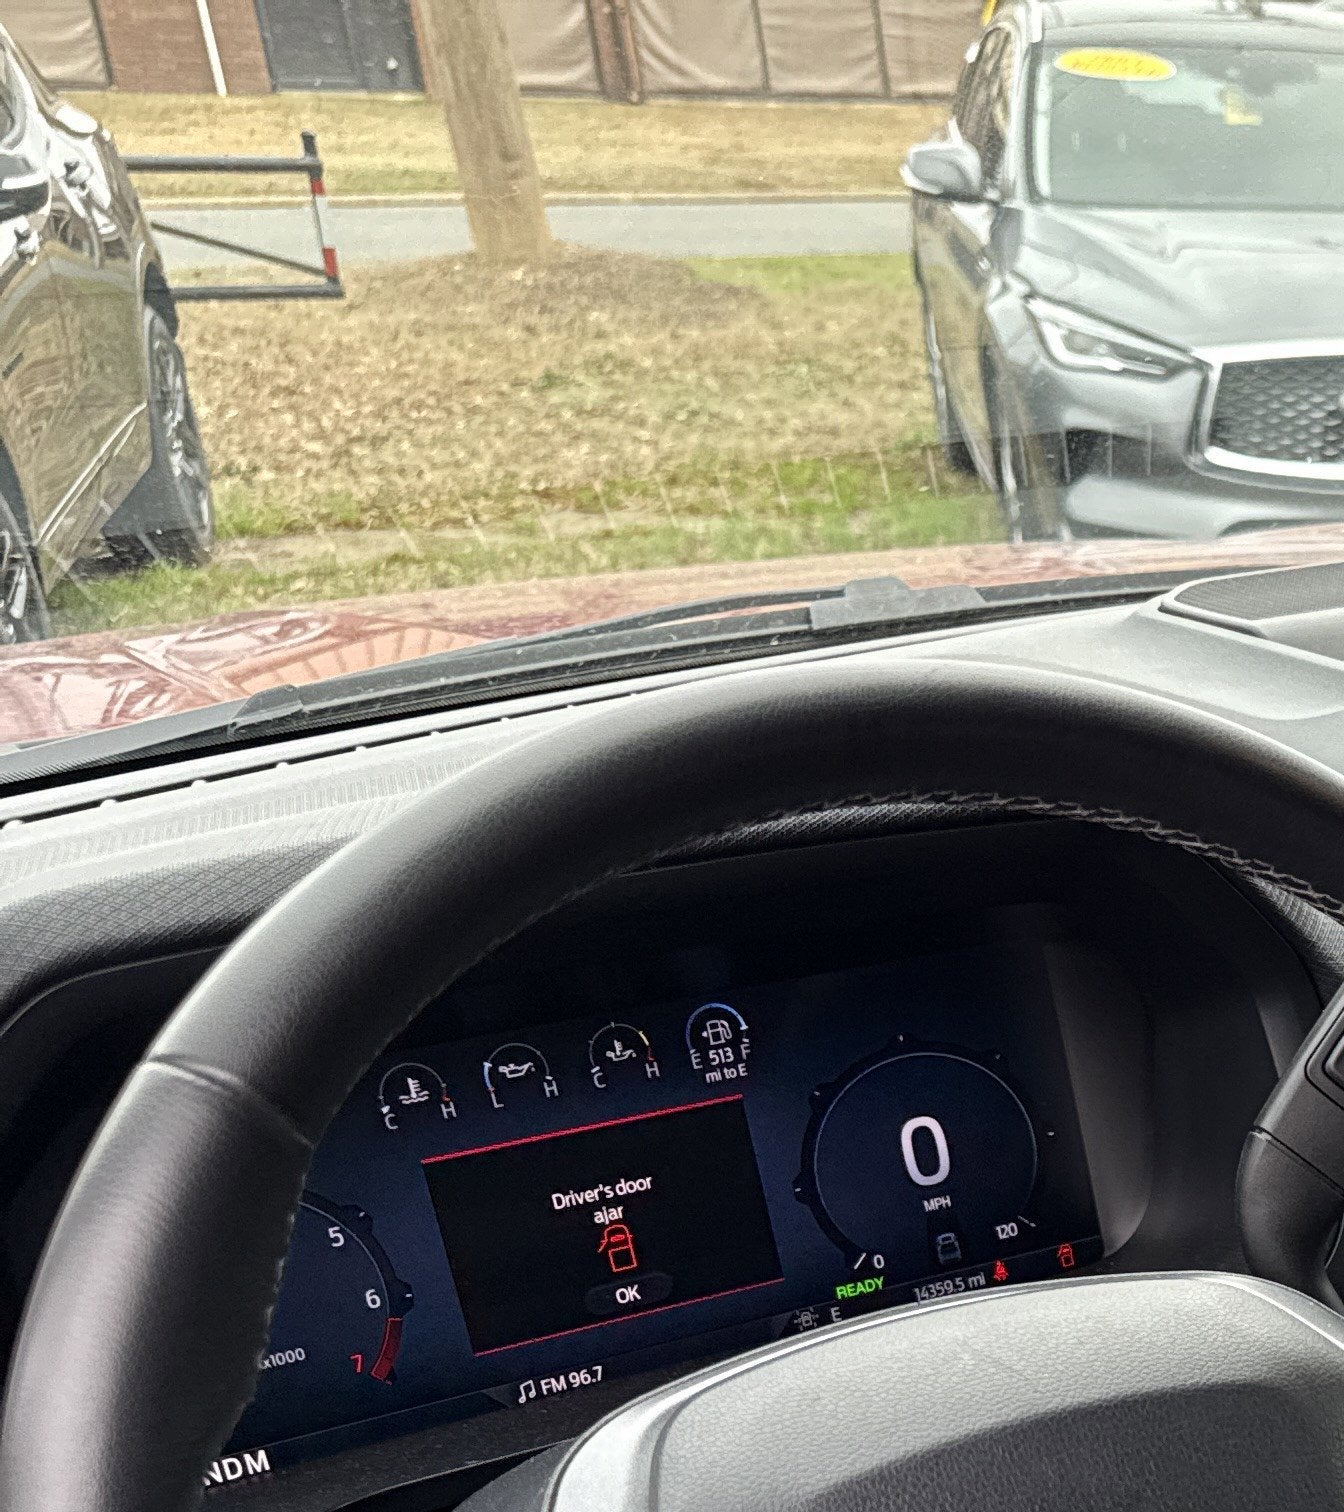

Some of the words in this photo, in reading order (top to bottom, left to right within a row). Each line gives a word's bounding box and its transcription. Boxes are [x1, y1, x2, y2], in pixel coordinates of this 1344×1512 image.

[708, 1047, 734, 1065] 513
[705, 1068, 722, 1083] mi
[723, 1067, 737, 1079] to
[738, 1063, 748, 1077] E
[900, 1115, 951, 1187] 0
[551, 1183, 613, 1210] Driver's
[615, 1176, 652, 1197] door
[593, 1203, 625, 1225] ajar
[924, 1195, 952, 1213] MPH
[328, 1226, 345, 1248] 5
[995, 1222, 1019, 1240] 120
[615, 1285, 641, 1305] OK
[835, 1276, 884, 1299] READY
[365, 1289, 381, 1309] 6
[350, 1354, 362, 1373] 7
[540, 1375, 567, 1396] FM
[568, 1366, 603, 1391] 96.7
